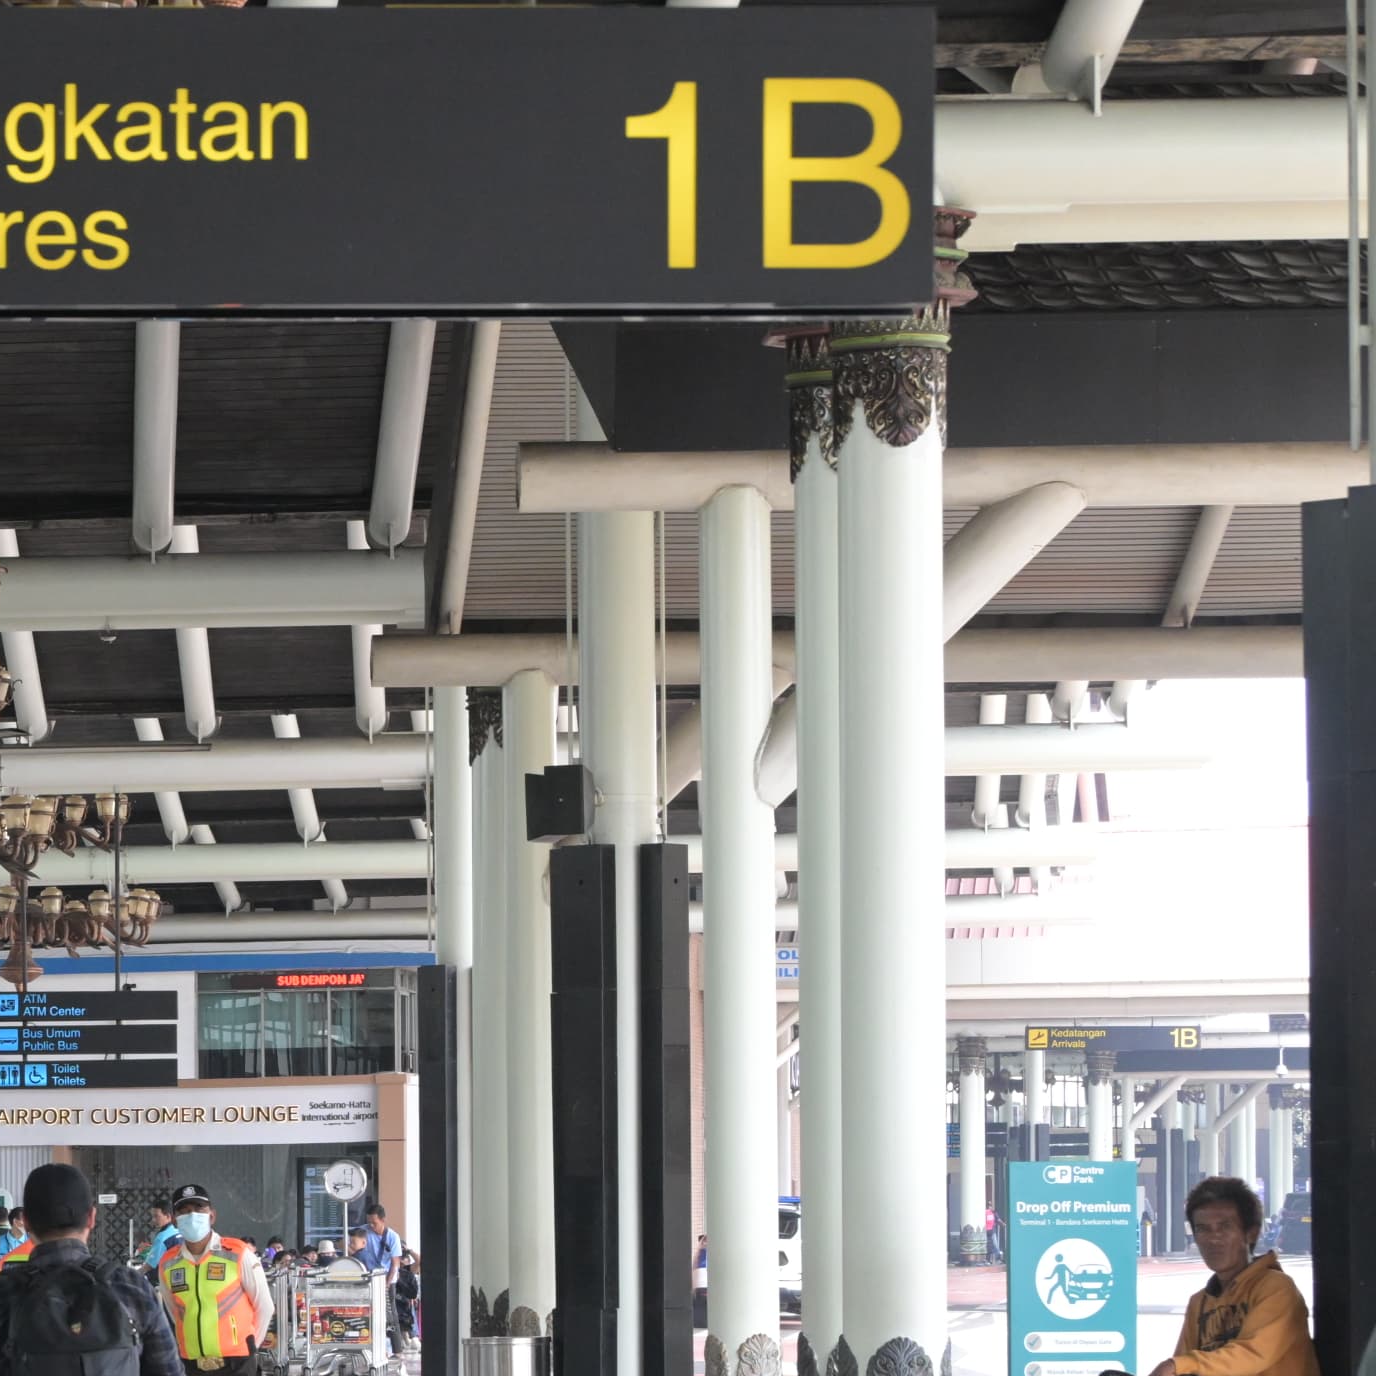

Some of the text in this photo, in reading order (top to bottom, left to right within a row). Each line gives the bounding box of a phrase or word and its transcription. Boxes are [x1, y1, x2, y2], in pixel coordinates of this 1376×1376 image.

[276, 974, 299, 987] SUB
[300, 973, 347, 986] DENPOM
[23, 994, 47, 1004] ATM
[23, 1006, 86, 1016] ATM Center
[22, 1028, 81, 1038] Bus Umum
[1050, 1027, 1198, 1049] Kedatangan 1B
[22, 1040, 79, 1051] Public Bus
[1051, 1039, 1086, 1049] Arrivals
[51, 1063, 80, 1073] Toilet
[51, 1075, 87, 1086] Toilets
[90, 1106, 206, 1125] CUSTOMER
[211, 1105, 300, 1124] LOUNGE
[301, 1111, 379, 1122] International airport
[1073, 1165, 1105, 1175] Centre
[1073, 1175, 1094, 1184] Park
[1016, 1200, 1131, 1216] Drop Off Premium
